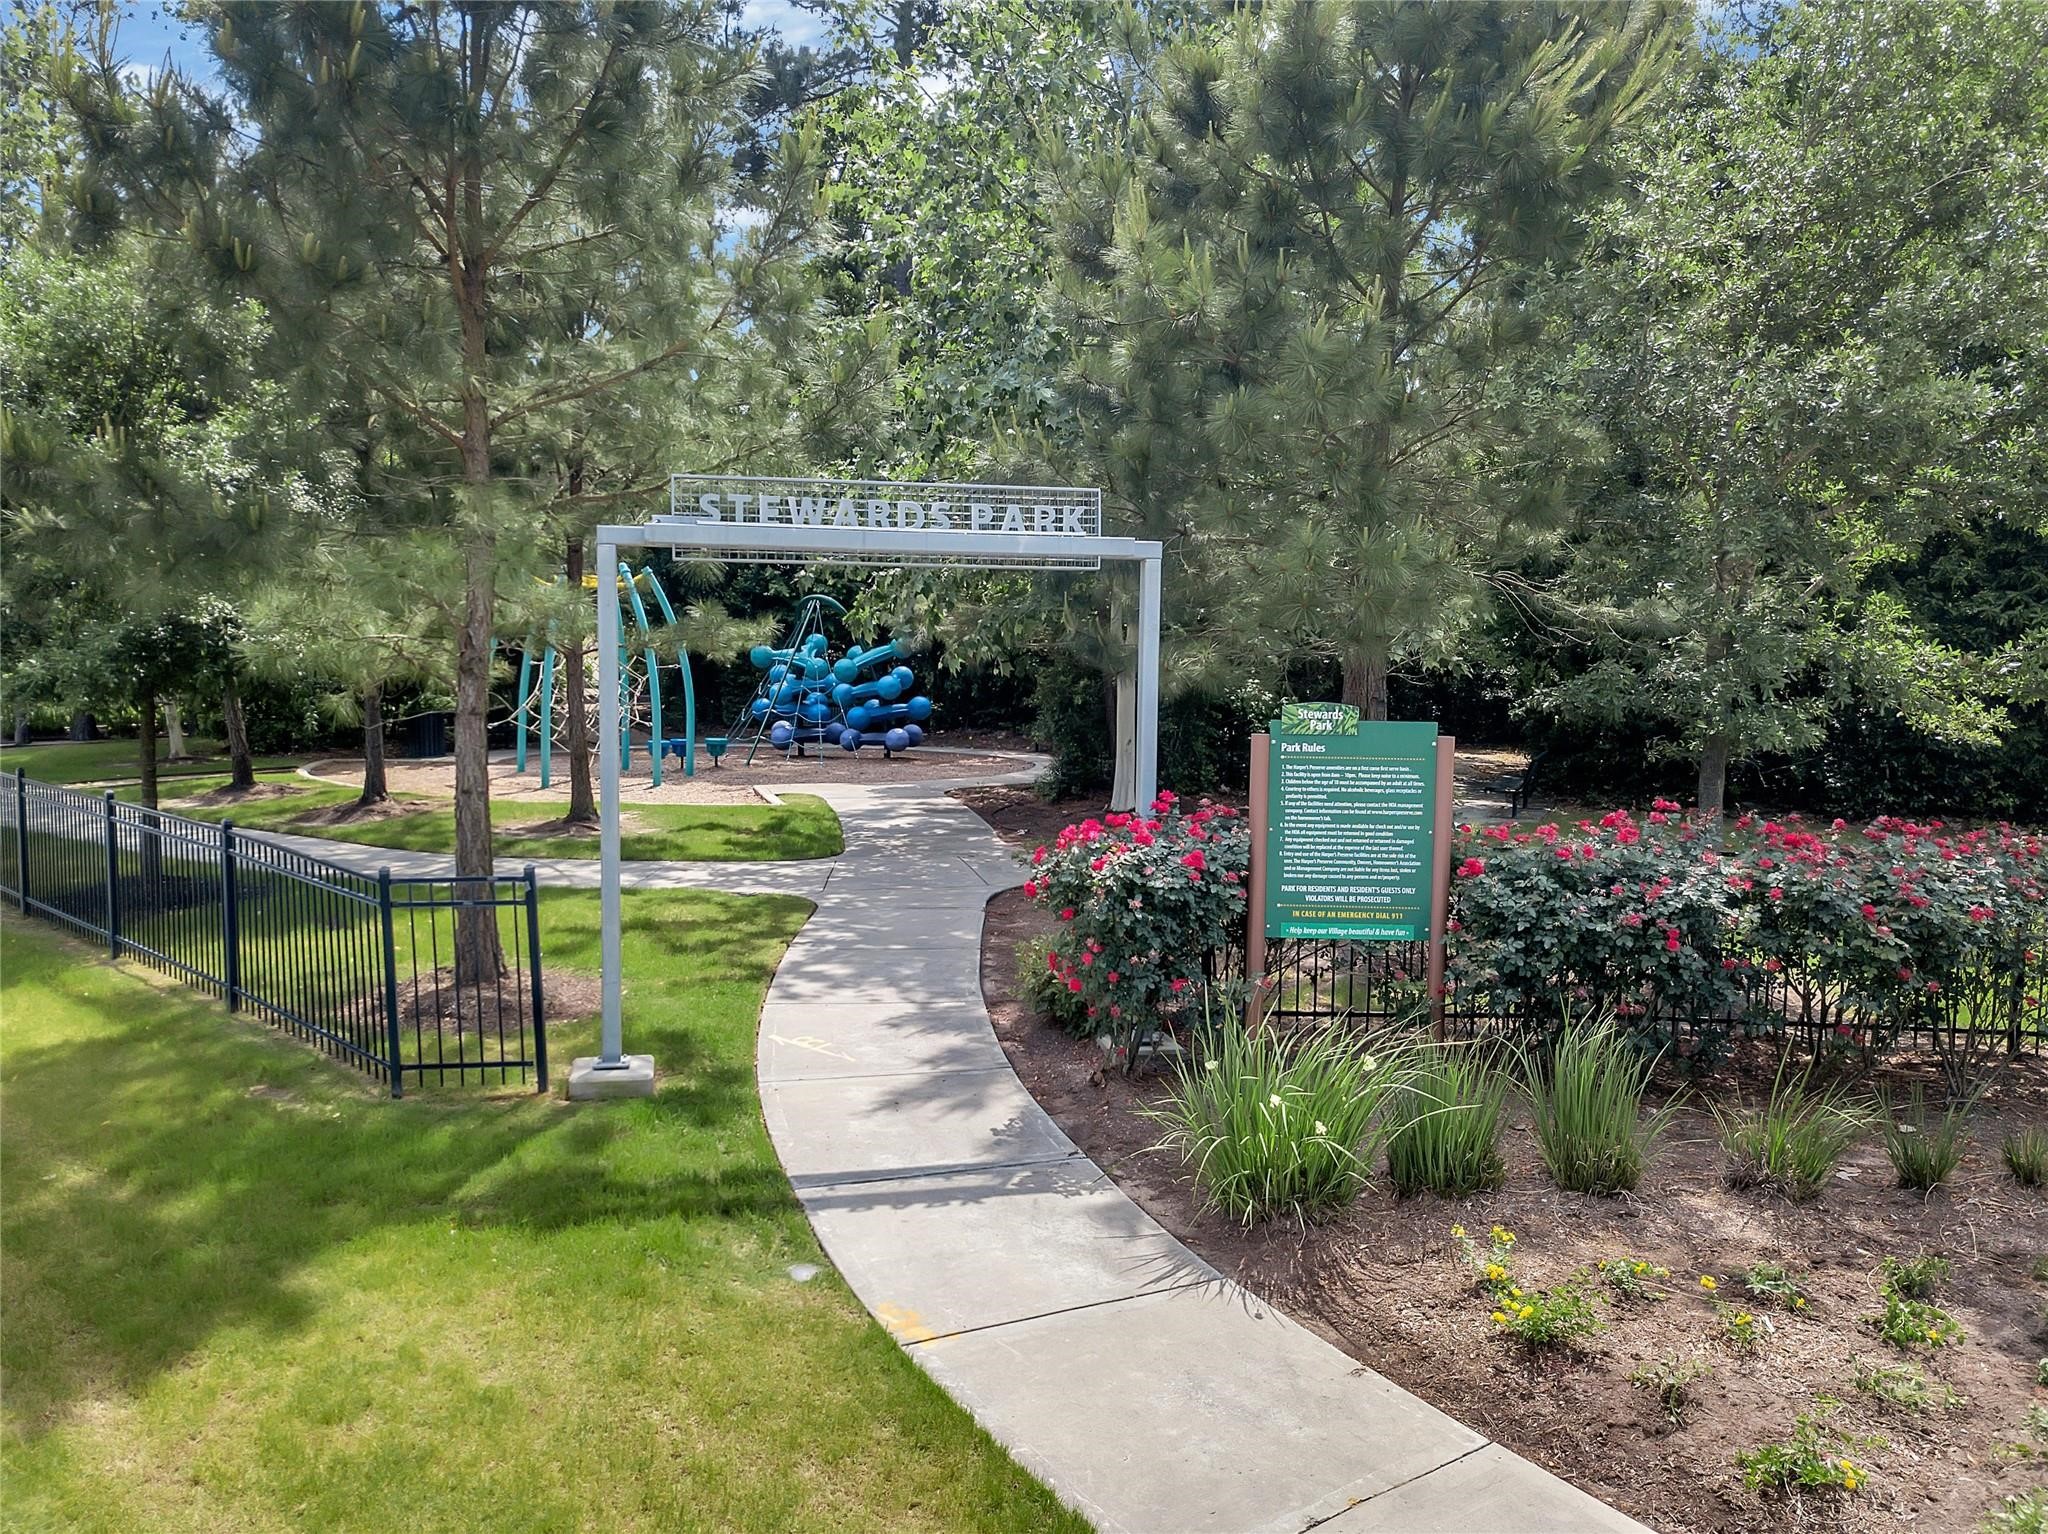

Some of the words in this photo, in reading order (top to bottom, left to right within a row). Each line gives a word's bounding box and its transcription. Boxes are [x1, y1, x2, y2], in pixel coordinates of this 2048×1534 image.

[698, 494, 950, 530] STEWARDS
[972, 503, 1086, 534] PARK
[1298, 708, 1344, 720] Stewards
[1310, 720, 1333, 730] Park
[1281, 743, 1301, 752] Park
[1302, 743, 1326, 752] Rules
[1290, 926, 1302, 935] Help
[1303, 927, 1316, 935] keep
[1328, 928, 1347, 936] Village
